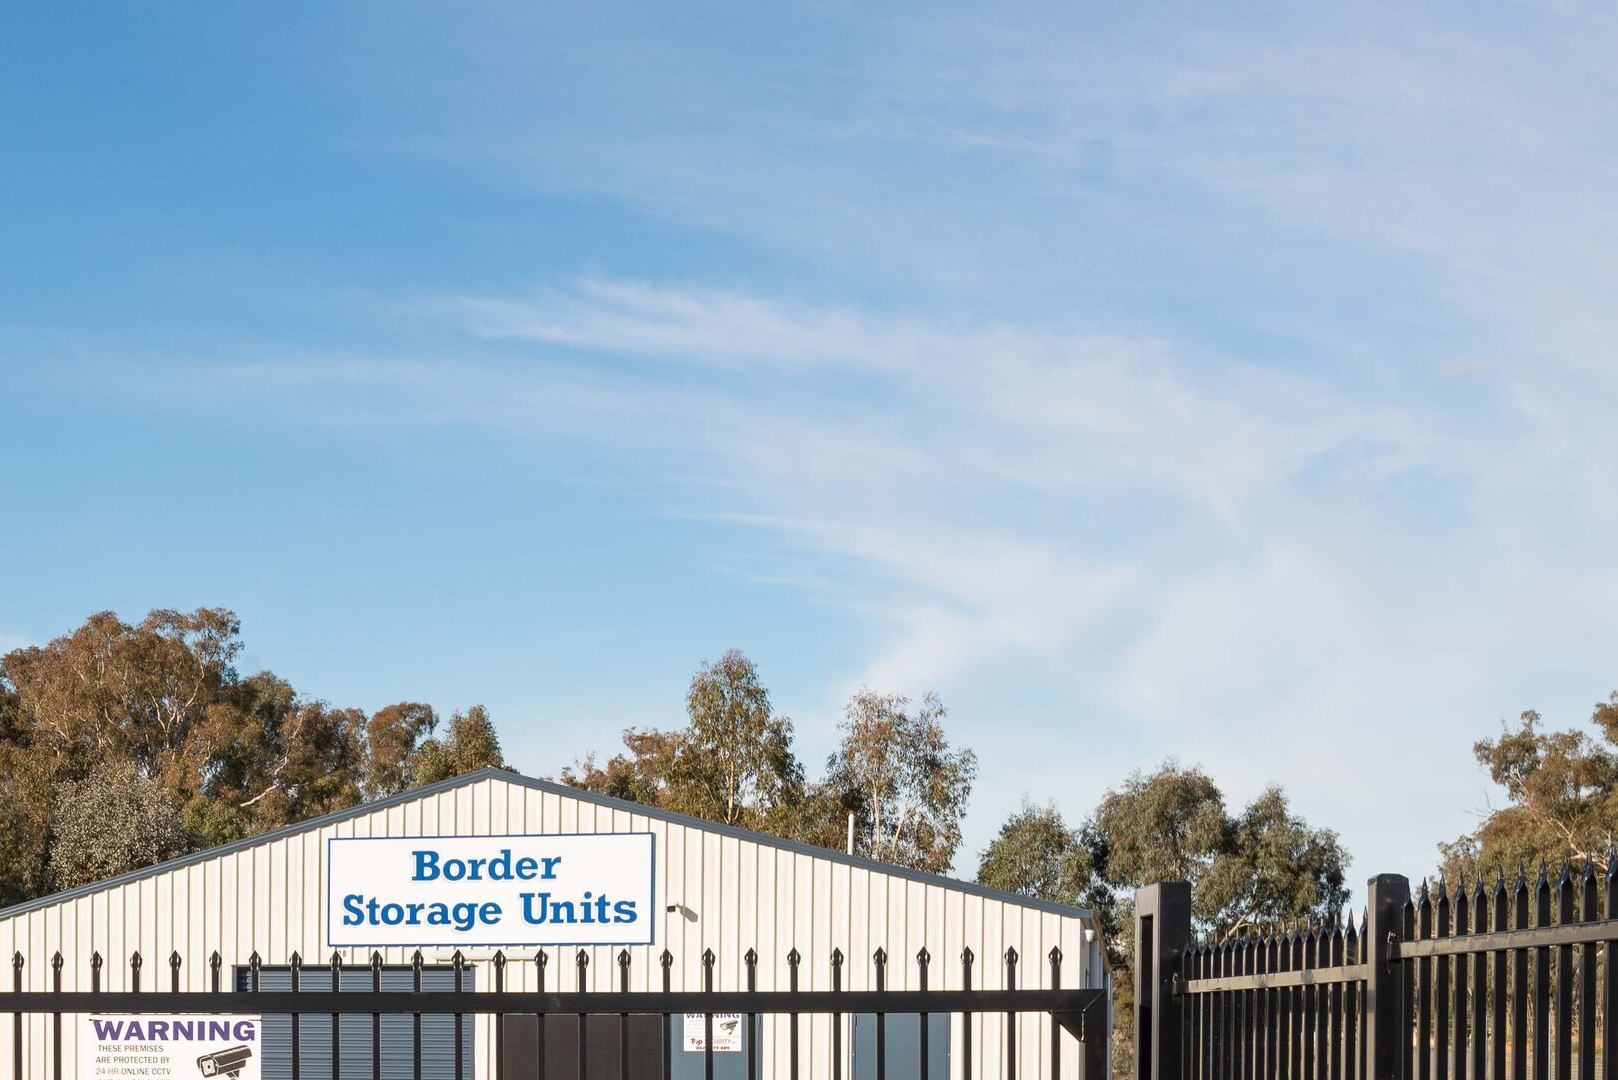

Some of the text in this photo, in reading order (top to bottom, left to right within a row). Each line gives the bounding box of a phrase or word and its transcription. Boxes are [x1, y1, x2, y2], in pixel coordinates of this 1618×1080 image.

[411, 849, 562, 881] Border
[343, 891, 638, 932] Storage Units
[93, 1020, 255, 1041] WARNING
[95, 1056, 171, 1064] ARE PROTECTED BY
[95, 1067, 171, 1075] 24 HR ONLINE CCTV
